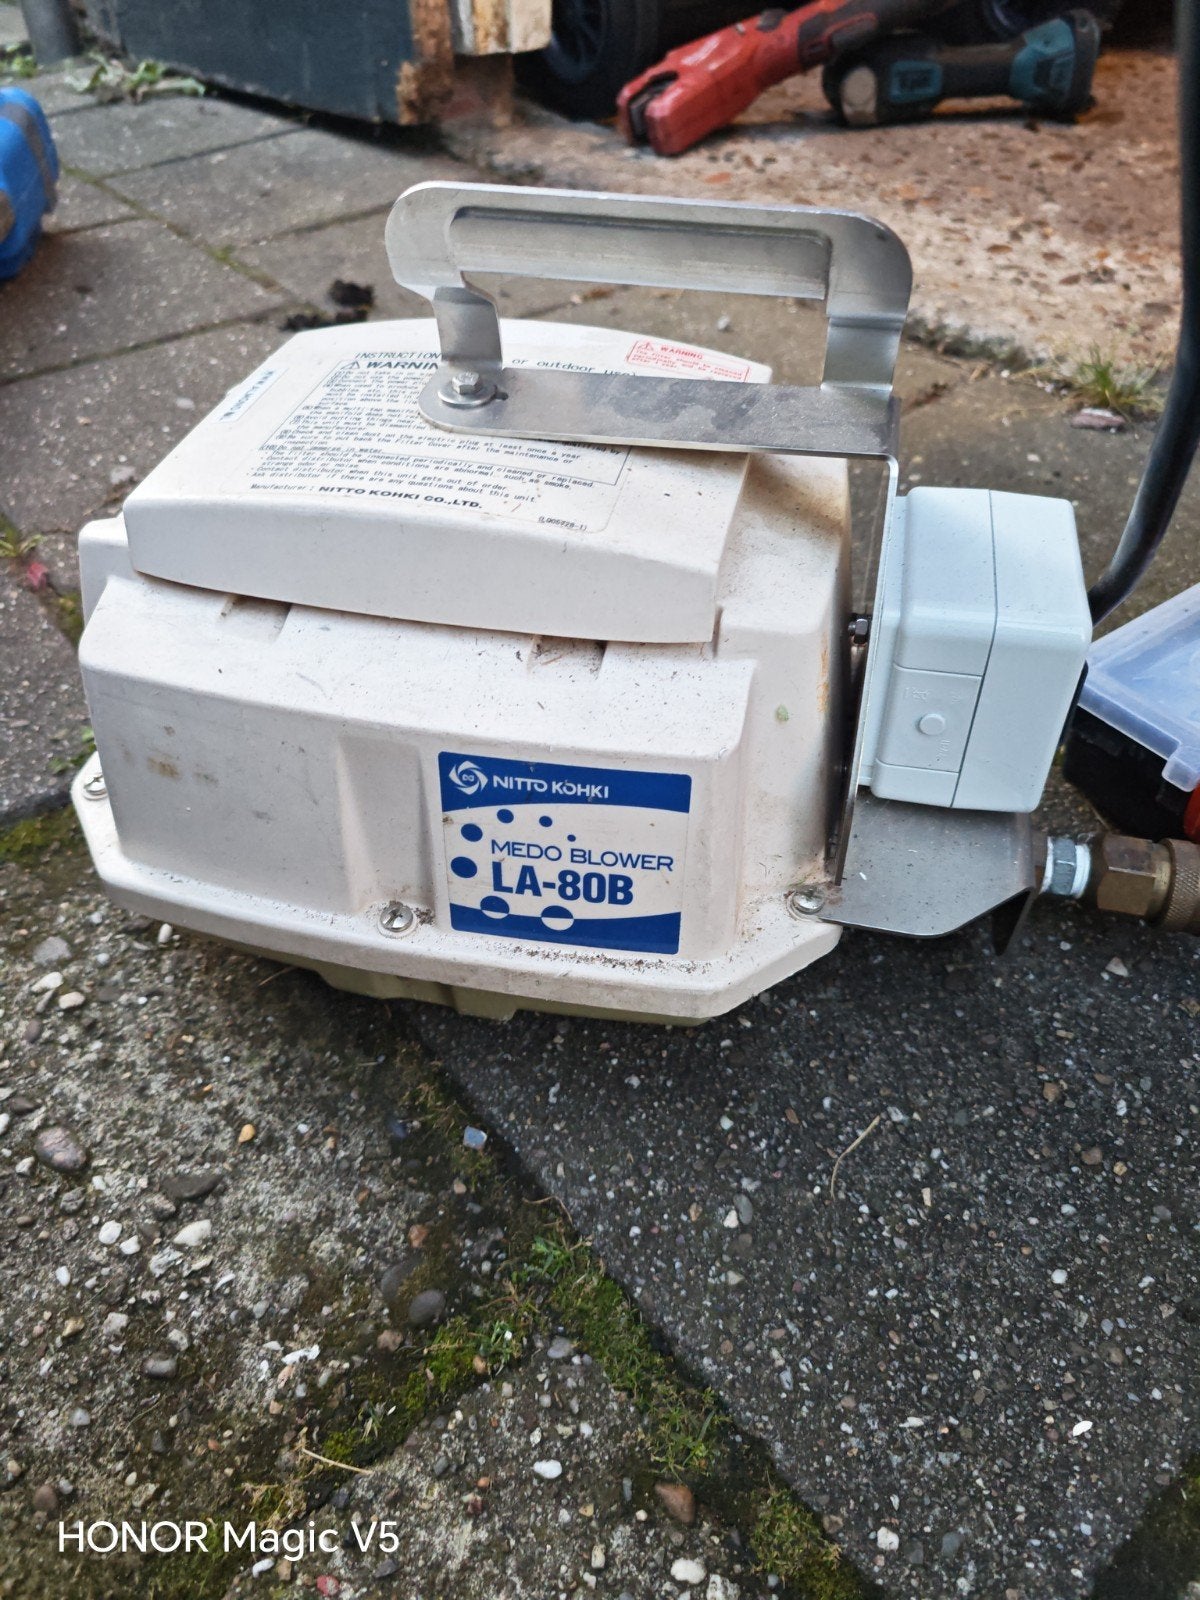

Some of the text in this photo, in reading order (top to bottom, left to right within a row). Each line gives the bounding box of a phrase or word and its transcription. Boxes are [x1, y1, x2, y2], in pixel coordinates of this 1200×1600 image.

[660, 345, 704, 360] WARNING
[366, 361, 439, 370] WARNIN
[536, 360, 596, 373] outdoor
[504, 450, 559, 462] maintenance
[374, 470, 393, 478] this
[496, 467, 533, 477] cleaned
[408, 480, 454, 490] questions
[458, 486, 484, 494] about
[490, 490, 510, 498] this
[318, 486, 366, 495] NITTO
[368, 488, 420, 500] KOHKI
[424, 494, 483, 509] CO.,LTD.
[493, 775, 609, 799] NITTO KOHKI
[491, 839, 674, 871] MEDO BLOWER
[491, 861, 634, 906] LA-80B
